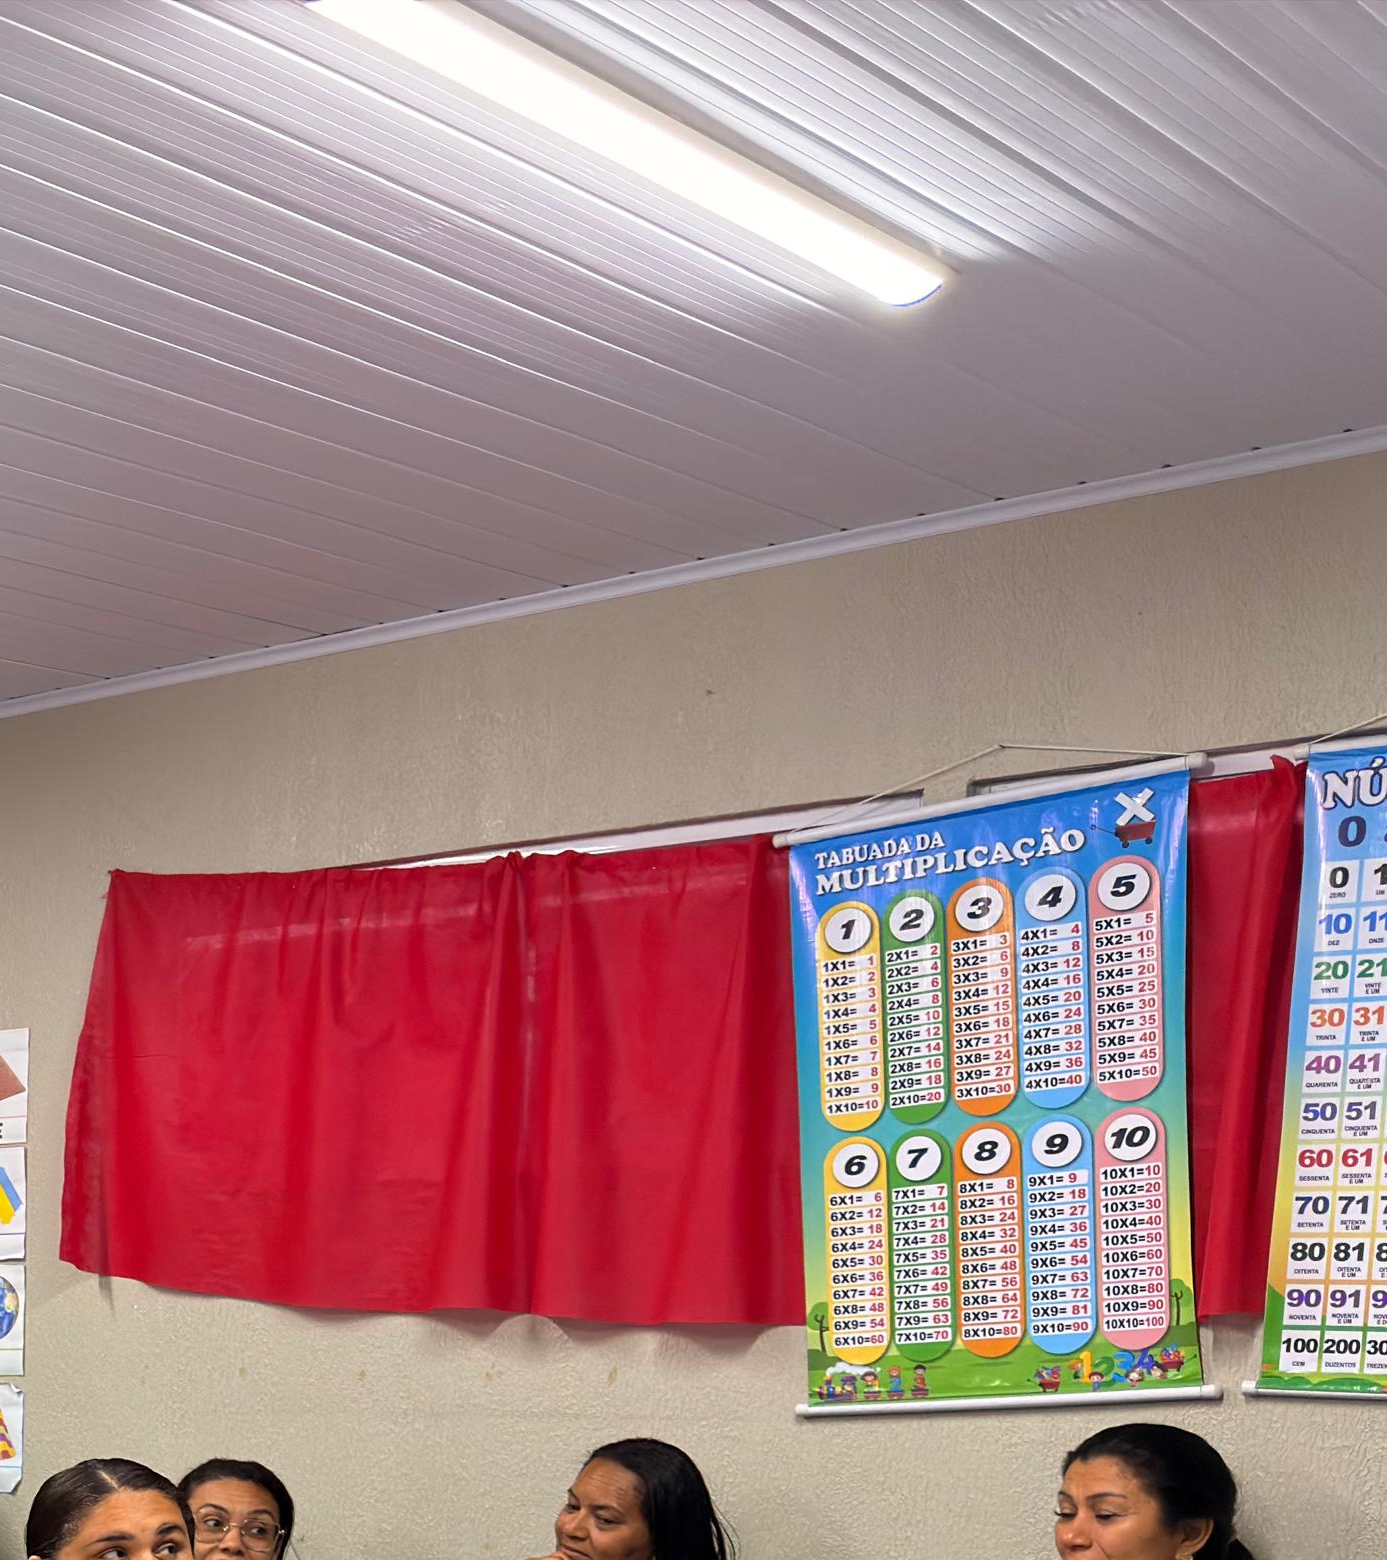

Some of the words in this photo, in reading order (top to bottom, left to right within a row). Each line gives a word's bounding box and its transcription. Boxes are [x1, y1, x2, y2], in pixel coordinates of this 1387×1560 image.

[1338, 816, 1367, 847] 0
[815, 838, 911, 871] TABUADA
[915, 831, 945, 851] DA
[815, 826, 1087, 897] MULTIPLICAÇÃO
[1110, 874, 1136, 897] 5
[1329, 866, 1349, 889] 0
[1036, 885, 1064, 908] 4
[966, 897, 992, 920] 3
[839, 918, 857, 941] 1
[899, 908, 925, 931] 2
[1318, 912, 1353, 935] 10
[1313, 960, 1350, 981] 20
[1309, 1007, 1345, 1028] 30
[1099, 1065, 1157, 1082] 5X10=50
[1305, 1055, 1342, 1075] 40
[1302, 1102, 1338, 1122] 50
[1043, 1133, 1070, 1155] 9
[1109, 1125, 1151, 1150] 10
[906, 1147, 929, 1169] 7
[973, 1140, 999, 1162] 8
[1298, 1148, 1334, 1168] 60
[843, 1154, 868, 1176] 6
[1102, 1165, 1161, 1180] 10X1=10
[1102, 1182, 1161, 1197] 10X2=20
[1294, 1195, 1330, 1215] 70
[1103, 1232, 1162, 1247] 10X5=50
[1290, 1242, 1326, 1262] 80
[1286, 1289, 1322, 1308] 90
[1032, 1321, 1089, 1335] 9X10=90
[1105, 1316, 1164, 1330] 10X10=100
[834, 1334, 884, 1347] 6X10=60
[1281, 1337, 1319, 1354] 100
[1323, 1338, 1361, 1355] 200
